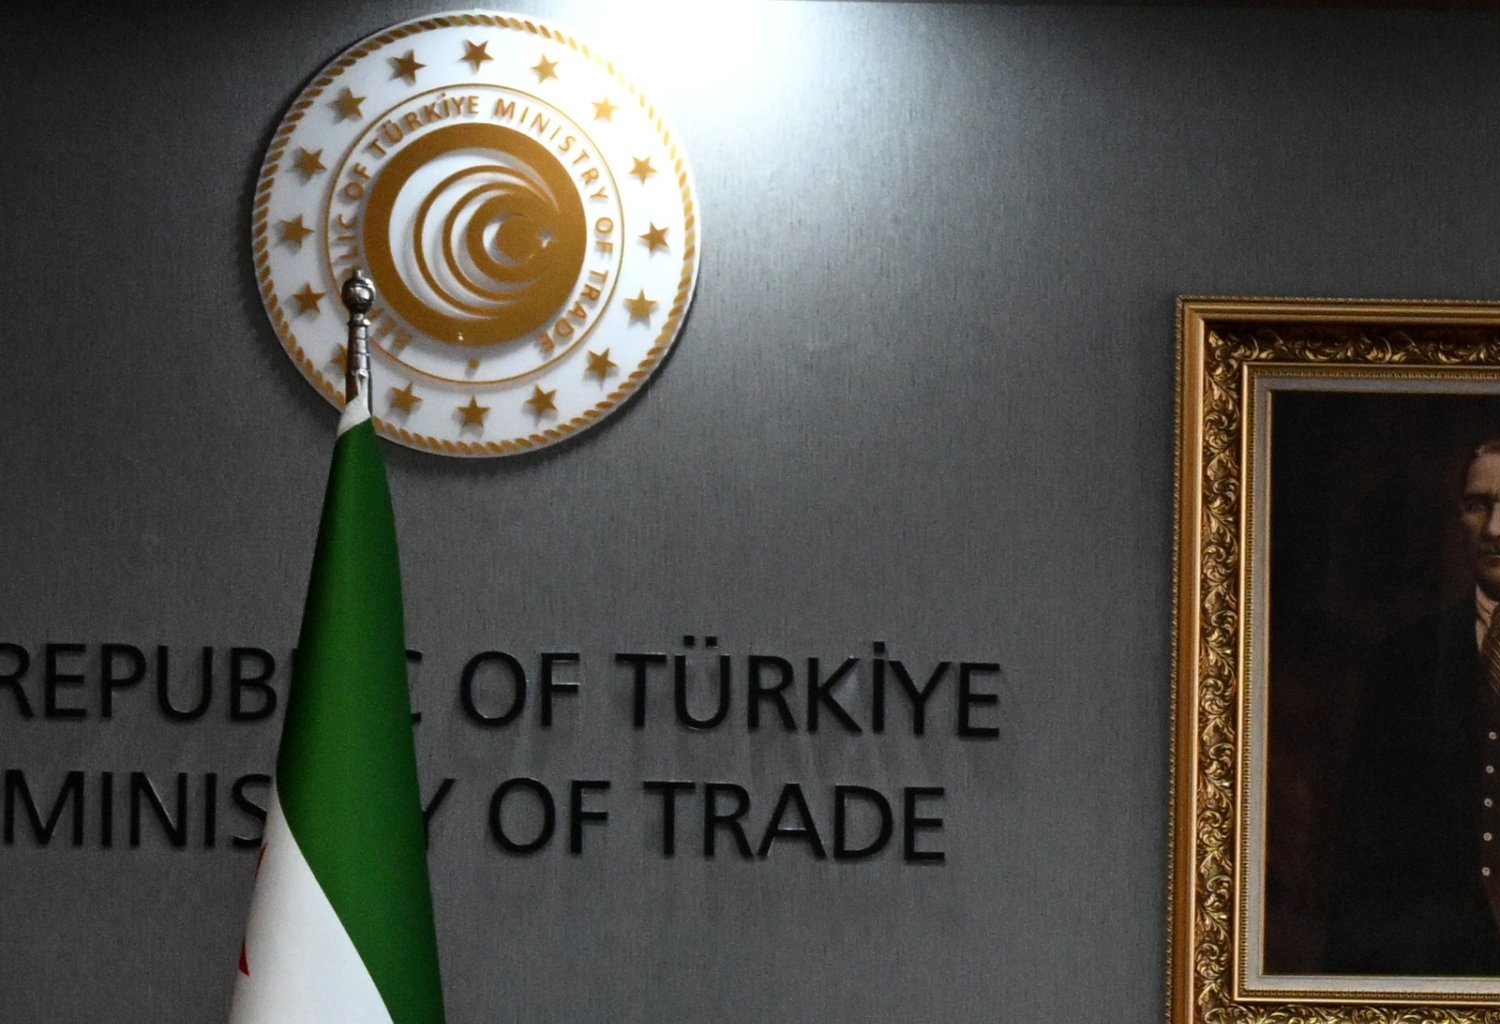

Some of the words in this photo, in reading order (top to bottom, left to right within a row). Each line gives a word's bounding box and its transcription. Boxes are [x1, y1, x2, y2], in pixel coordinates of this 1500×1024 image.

[367, 92, 480, 156] TÜRKİYE
[493, 98, 609, 199] MINISTRY
[344, 163, 371, 200] OF
[595, 217, 614, 253] OF
[536, 270, 609, 352] TRADE
[0, 642, 422, 727] REPUB
[460, 650, 581, 728] OF
[615, 635, 1000, 737] TÜRKİYE
[489, 777, 611, 856] OF
[643, 779, 946, 863] TRADE
